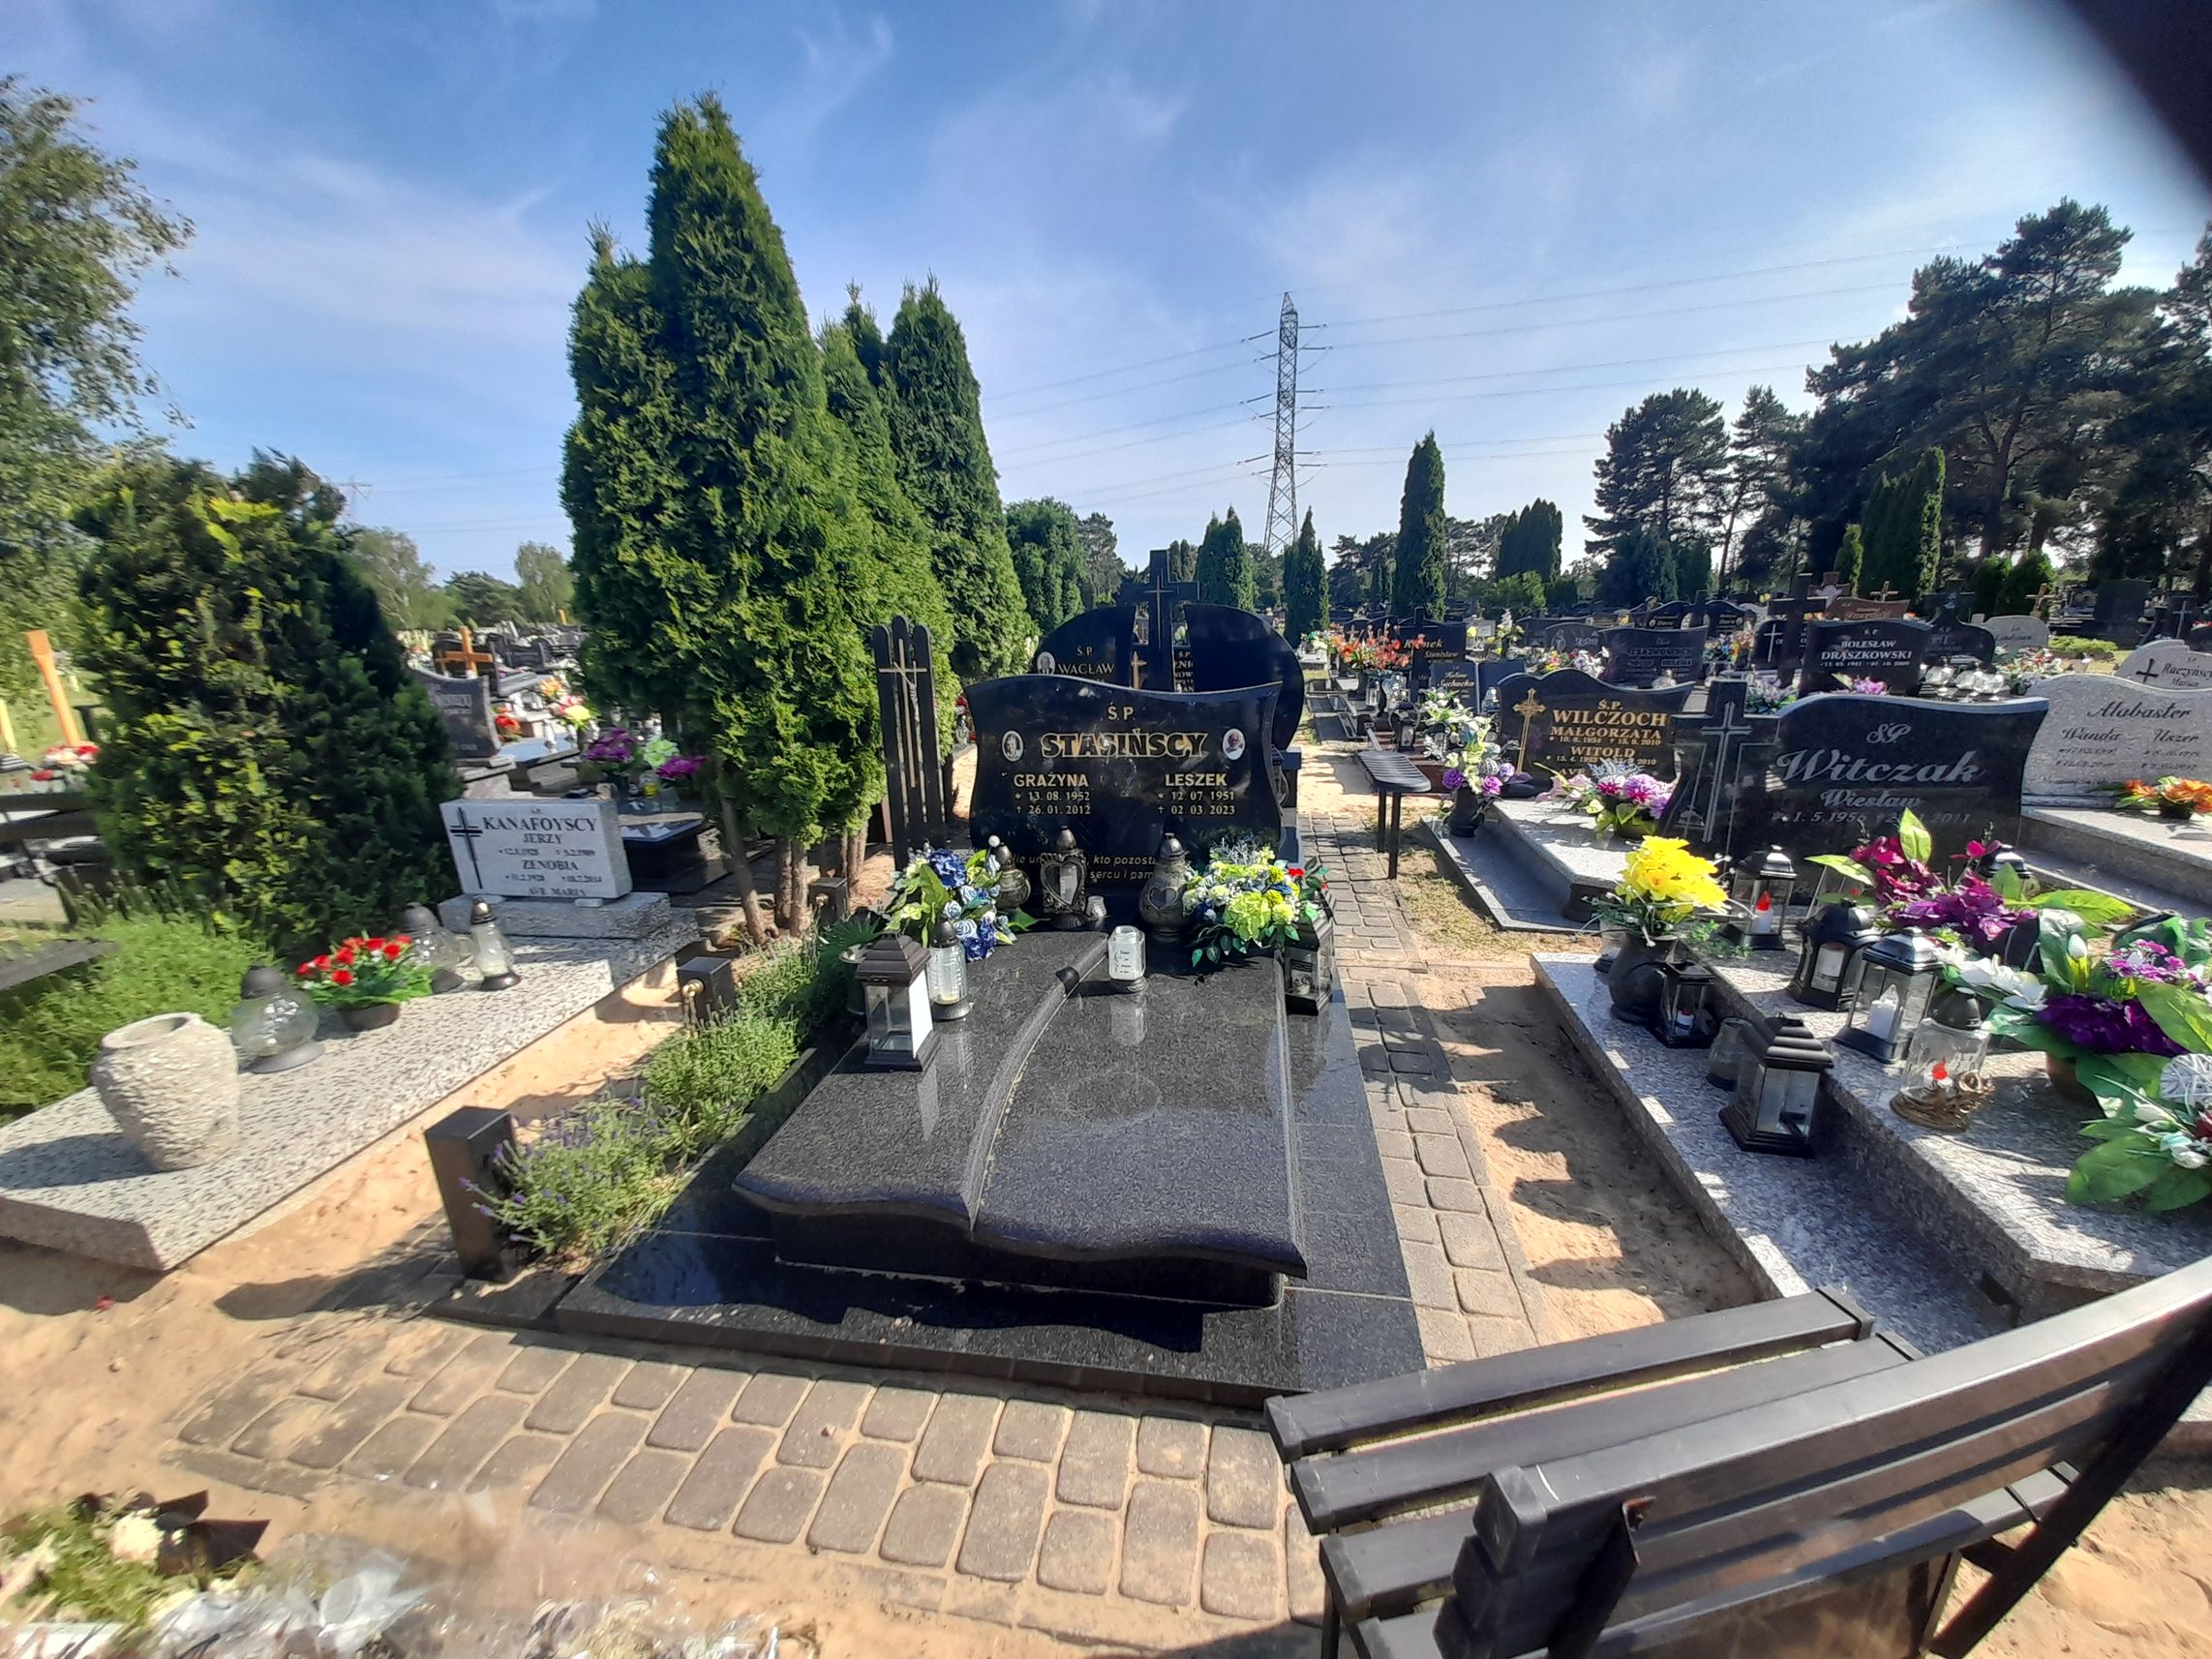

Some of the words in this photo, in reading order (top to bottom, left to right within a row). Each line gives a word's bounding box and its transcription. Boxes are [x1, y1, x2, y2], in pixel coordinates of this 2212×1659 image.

[1841, 640, 1897, 649] BOLESŁAW
[1820, 650, 1913, 662] DRĄSZKOWSKI
[1058, 662, 1115, 675] WACŁAW
[1553, 709, 1668, 727] WILCZOCH
[1550, 726, 1662, 739] MAŁGORZATA
[2062, 727, 2122, 741] Wanda
[1041, 728, 1209, 758] STASIŃSCY
[1570, 746, 1636, 758] WITOLD
[1776, 748, 1981, 782] Witczak
[1014, 770, 1089, 787] GRAŻYNA
[1165, 773, 1227, 786] LESZEK
[1066, 791, 1090, 800] 1952
[1210, 791, 1234, 800] 1951
[1820, 789, 1924, 807] Wiesław
[1066, 804, 1091, 815] 2012
[1209, 804, 1235, 815] 2023
[482, 816, 597, 831] KANAFOYSCY
[523, 832, 562, 844] JERZY
[522, 860, 579, 870] ZENOBIA
[1093, 855, 1111, 864] kto
